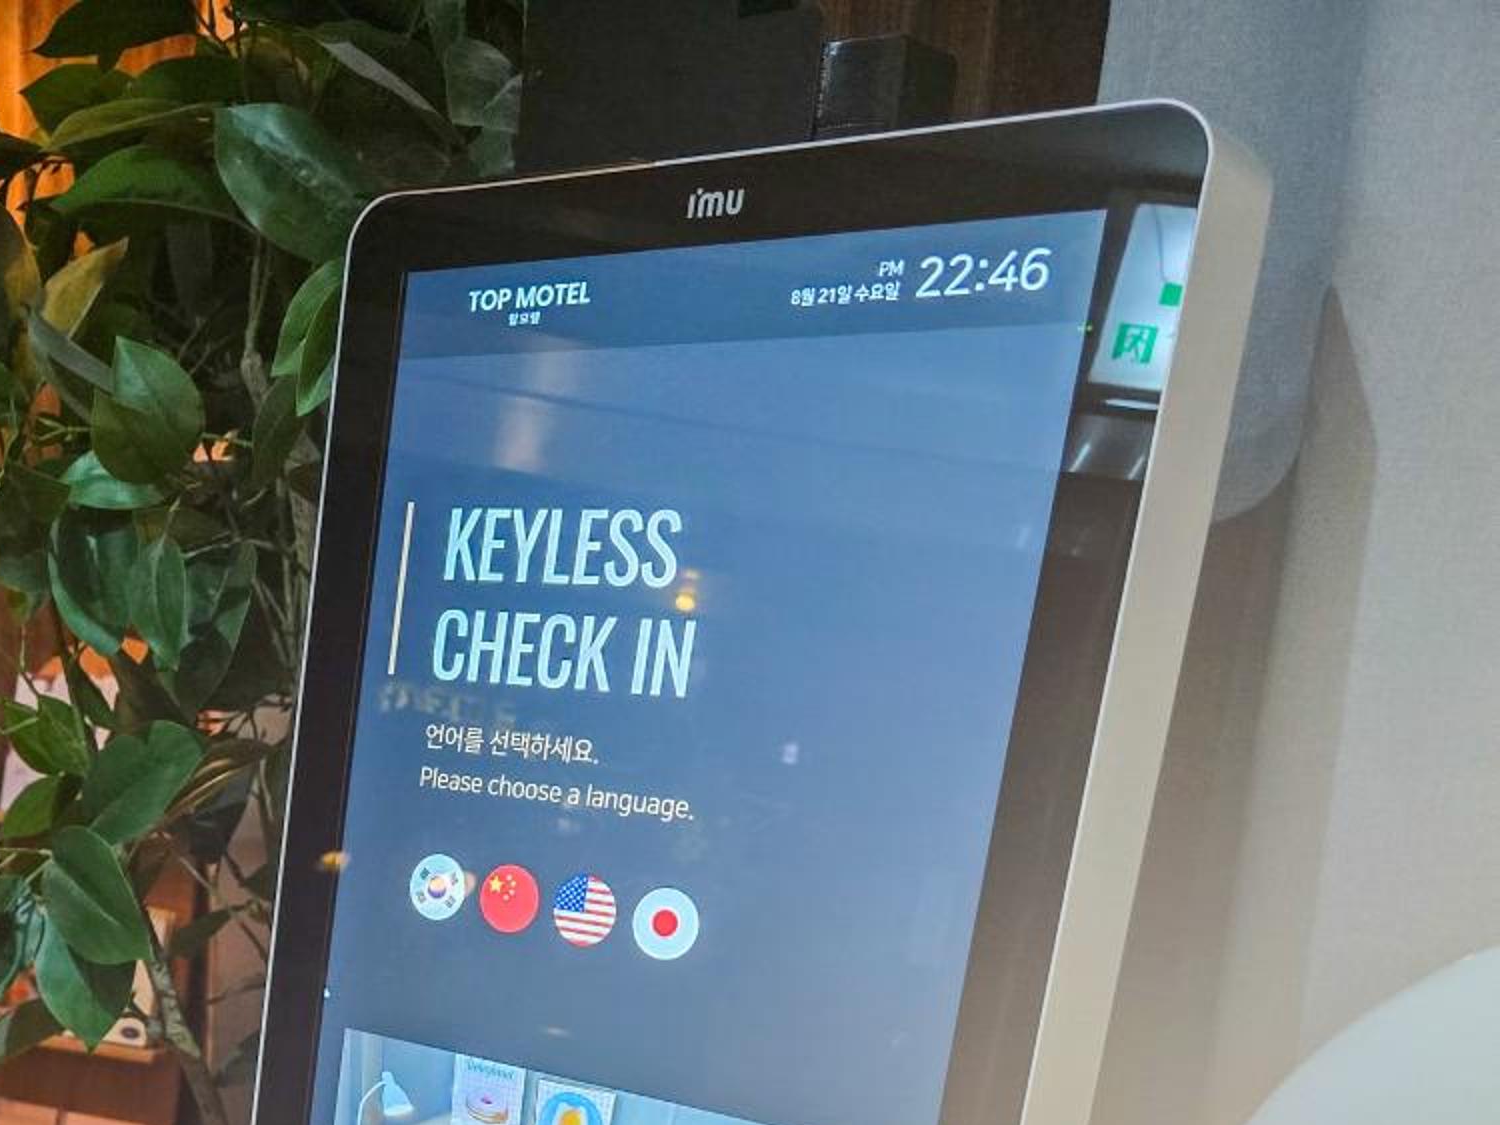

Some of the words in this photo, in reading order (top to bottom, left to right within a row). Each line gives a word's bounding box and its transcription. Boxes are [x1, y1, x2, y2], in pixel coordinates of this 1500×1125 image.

[879, 260, 905, 276] PM
[915, 247, 1052, 298] 22:46
[468, 287, 512, 312] TOP
[515, 281, 591, 309] MOTEL
[791, 286, 815, 306] 8월
[818, 285, 852, 304] 21일
[854, 281, 900, 302] 수요일
[443, 507, 683, 588] KEYLESS
[432, 608, 617, 693] CHECK
[630, 618, 697, 698] IN
[425, 724, 484, 754] 언어를
[489, 729, 599, 765] 선택하세요.
[419, 767, 482, 793] Please
[488, 775, 562, 804] choose
[567, 787, 581, 806] a
[586, 784, 694, 822] language.
